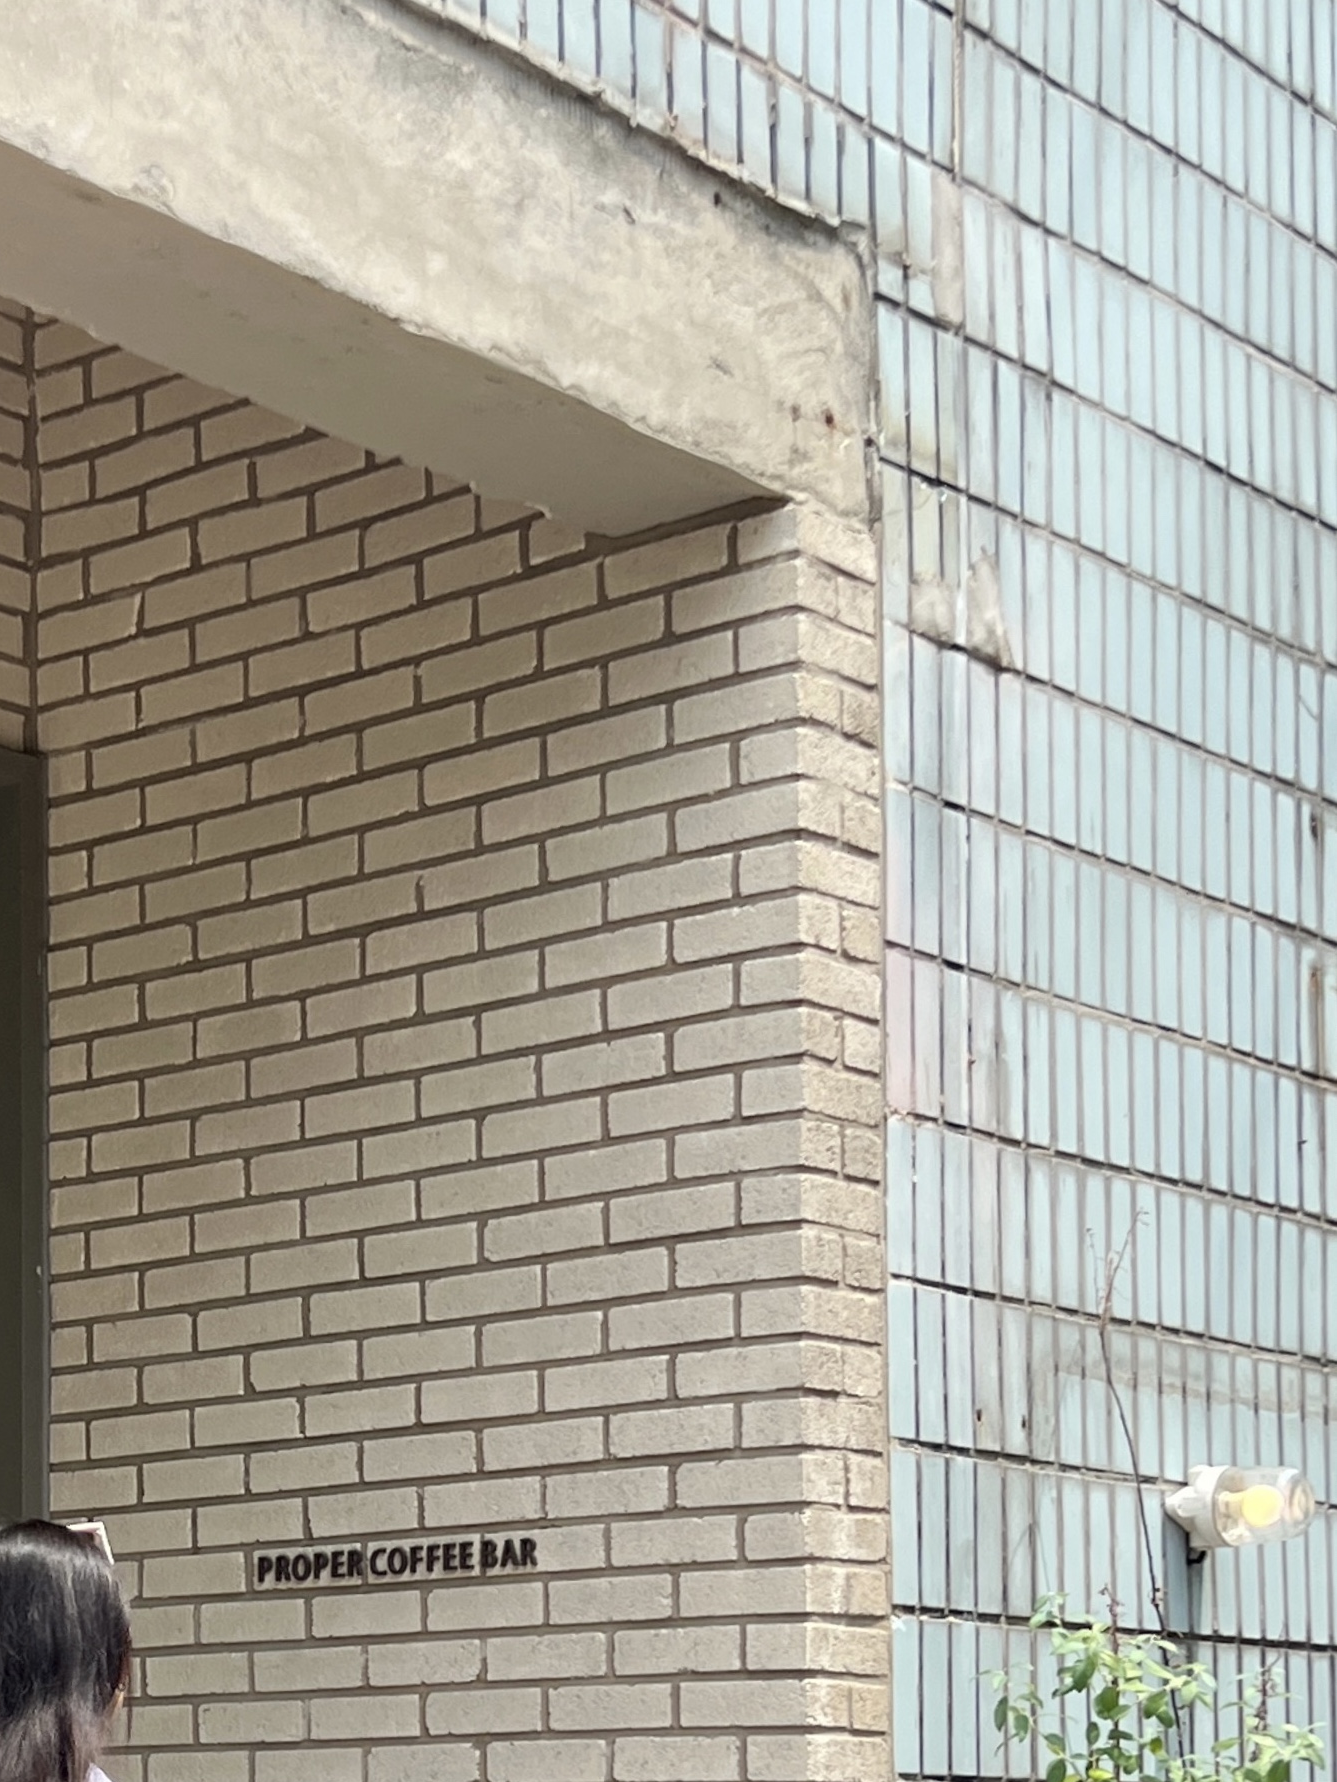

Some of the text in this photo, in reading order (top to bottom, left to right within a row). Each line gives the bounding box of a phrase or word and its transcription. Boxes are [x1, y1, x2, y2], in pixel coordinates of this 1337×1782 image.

[257, 1537, 538, 1584] PROPER COFFEE BAR
